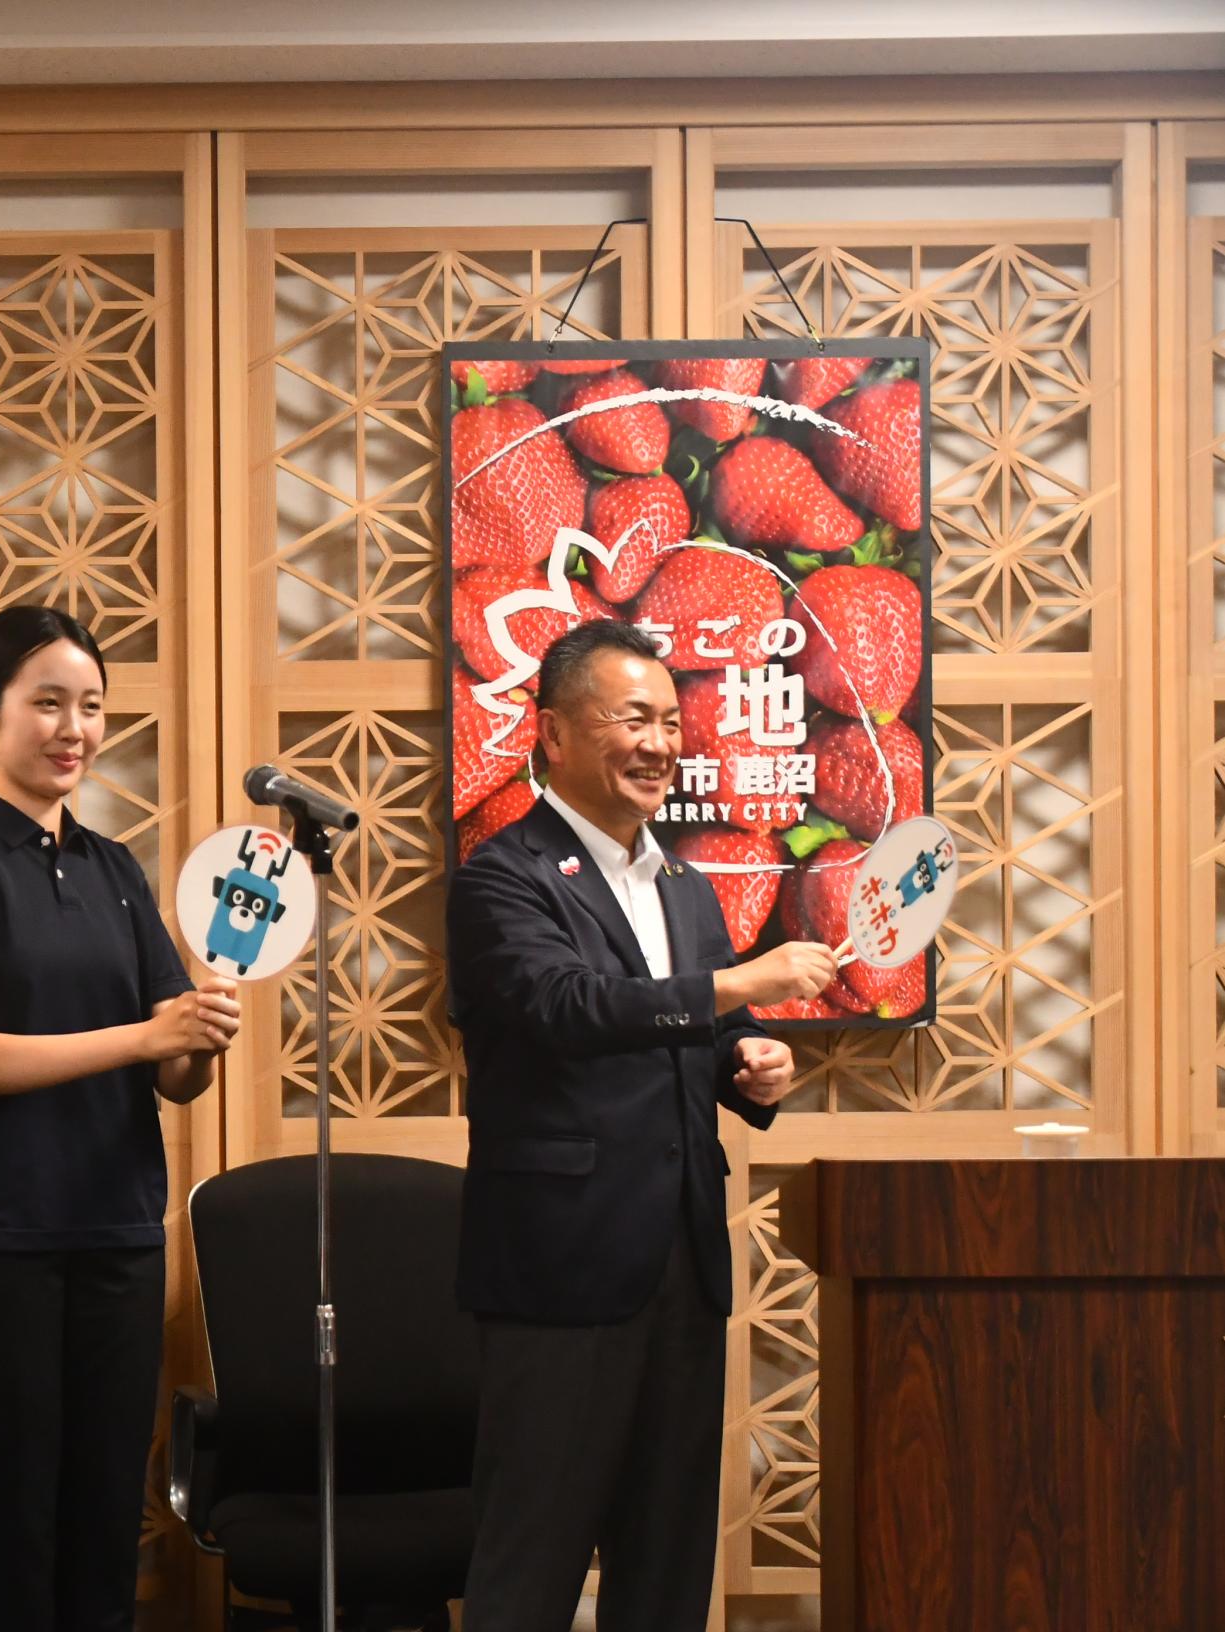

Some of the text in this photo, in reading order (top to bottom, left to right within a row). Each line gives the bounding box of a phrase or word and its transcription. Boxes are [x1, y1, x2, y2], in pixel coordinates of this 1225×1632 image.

[568, 616, 807, 658] ちごの
[717, 664, 807, 746] 地
[666, 754, 816, 796] 市 鹿沼
[643, 802, 808, 822] BERRY CITY
[860, 876, 899, 956] ポポカ
